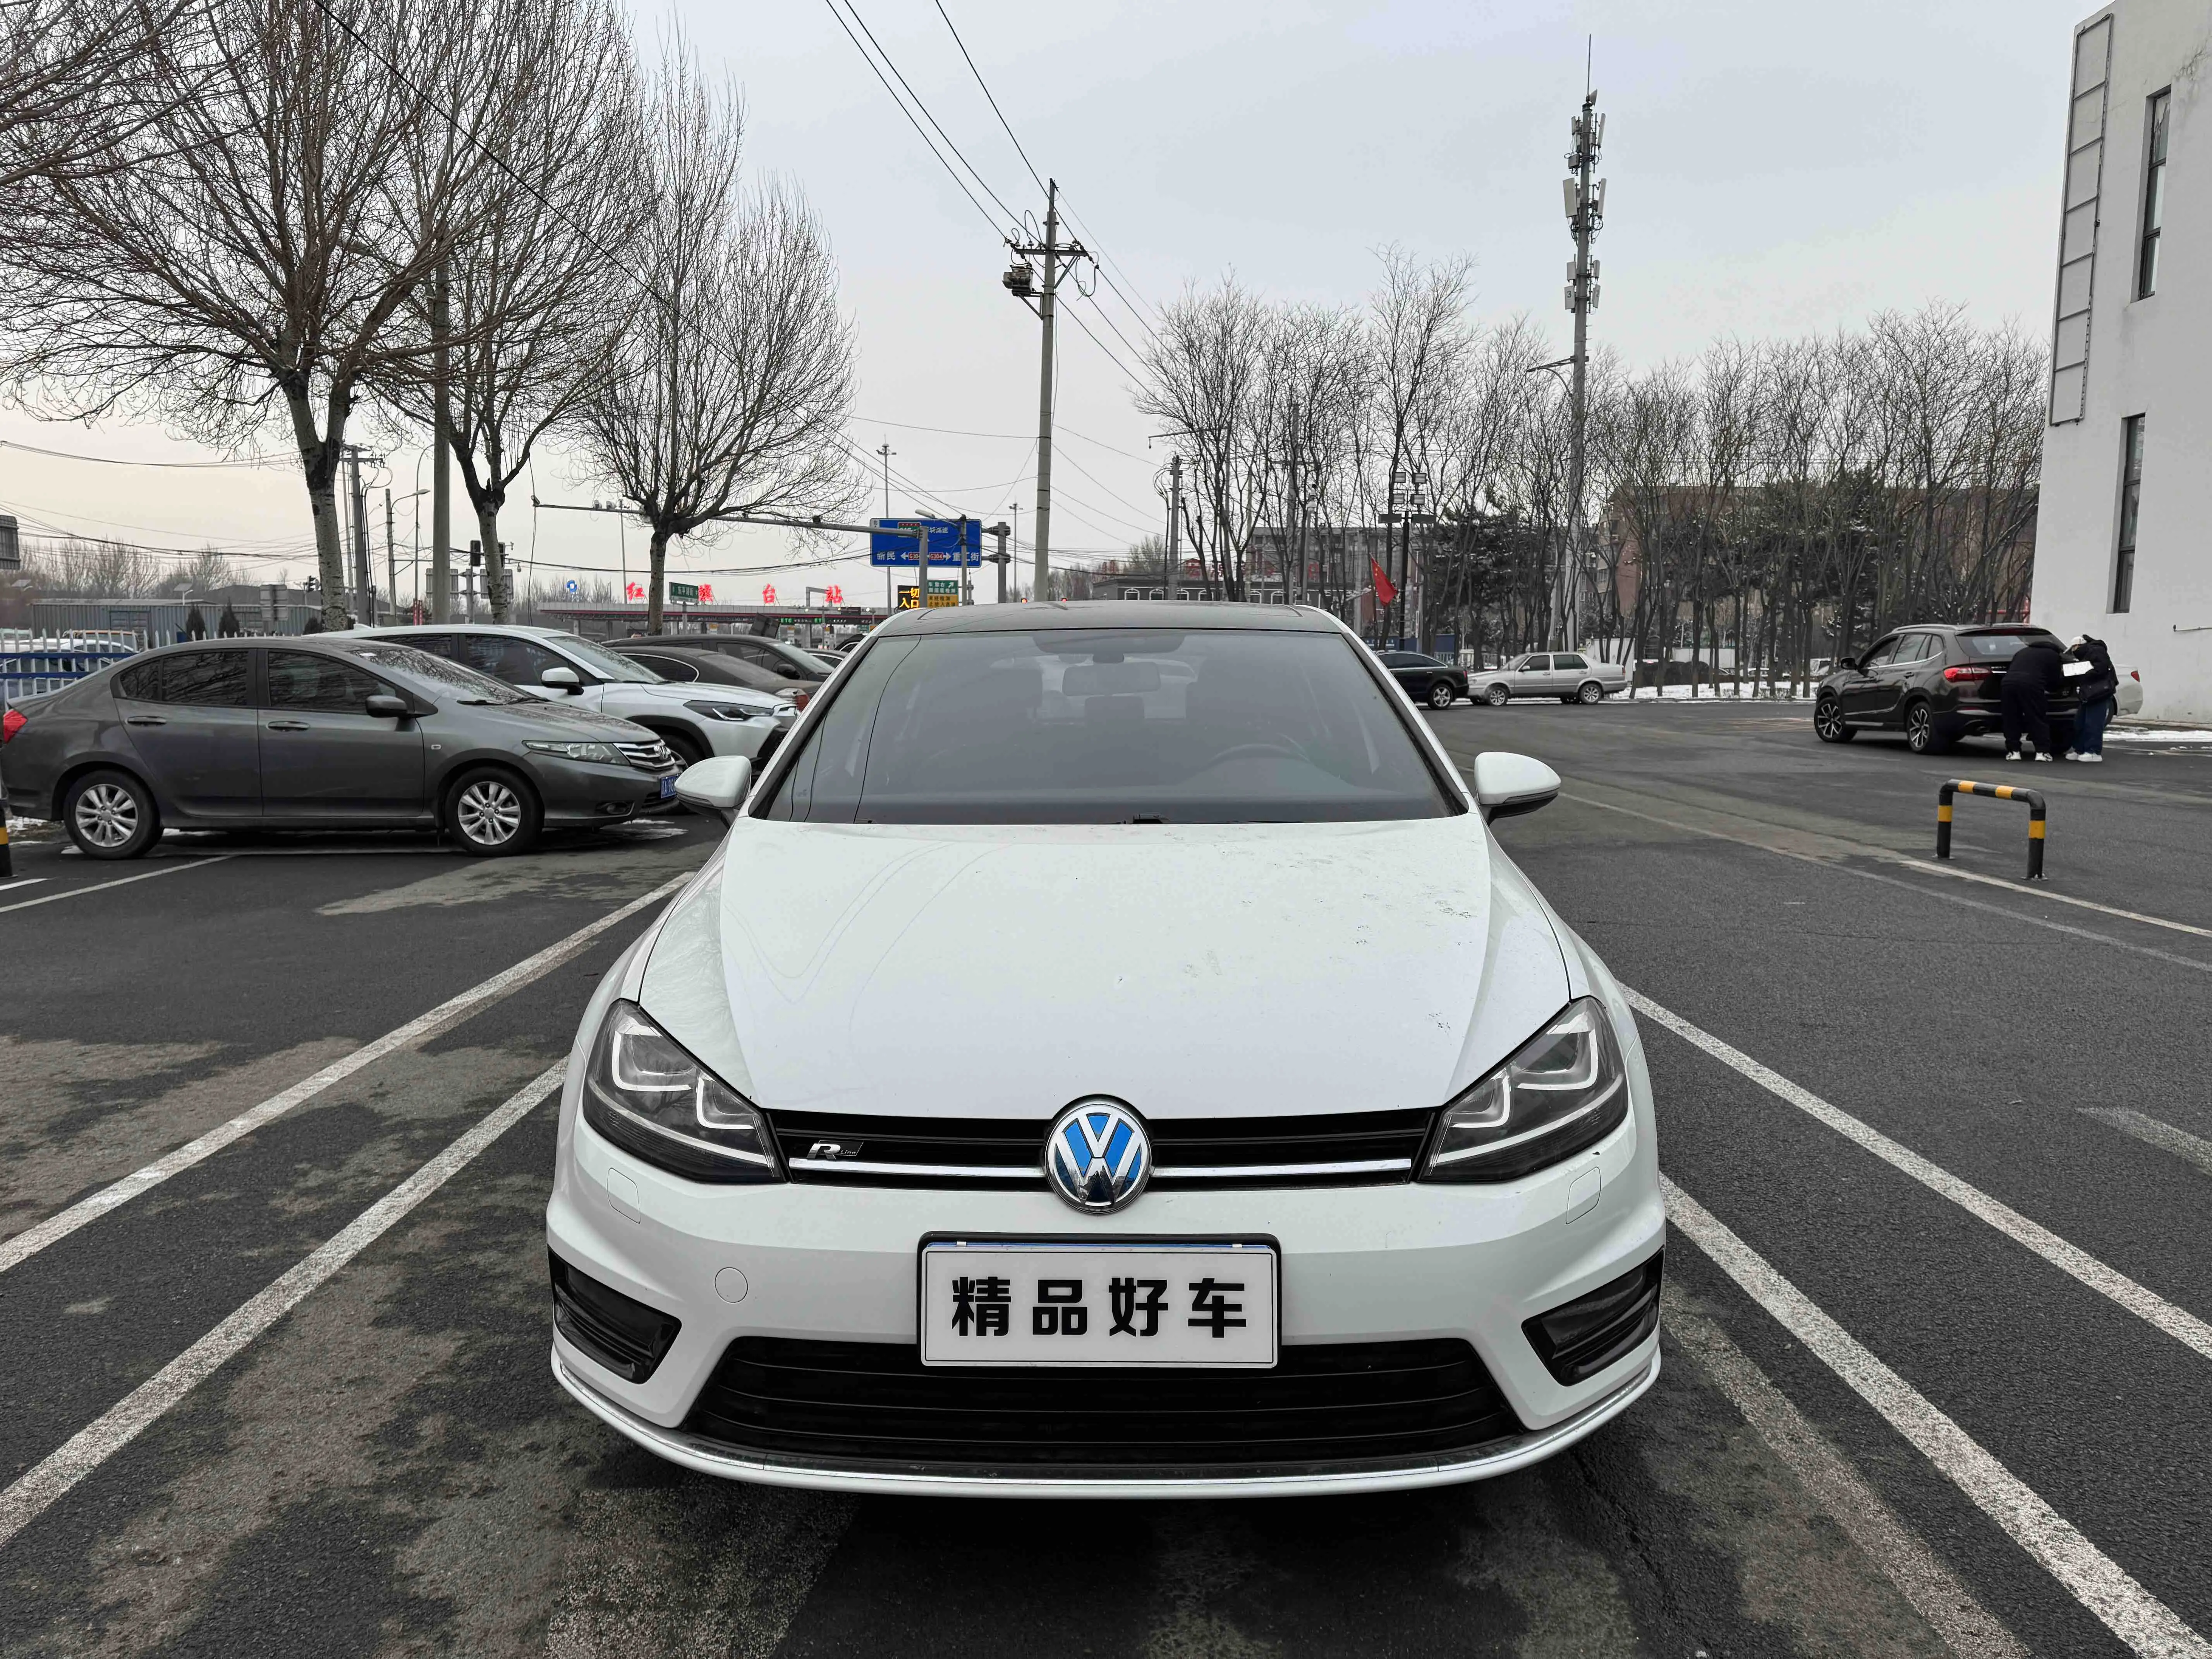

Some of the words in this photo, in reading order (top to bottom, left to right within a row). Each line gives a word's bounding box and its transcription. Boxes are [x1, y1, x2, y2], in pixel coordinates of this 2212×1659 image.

[877, 551, 895, 561] 新民
[898, 587, 920, 598] 一切
[899, 597, 920, 608] 入口
[807, 1143, 841, 1159] R
[951, 1276, 1247, 1338] 精品好车
